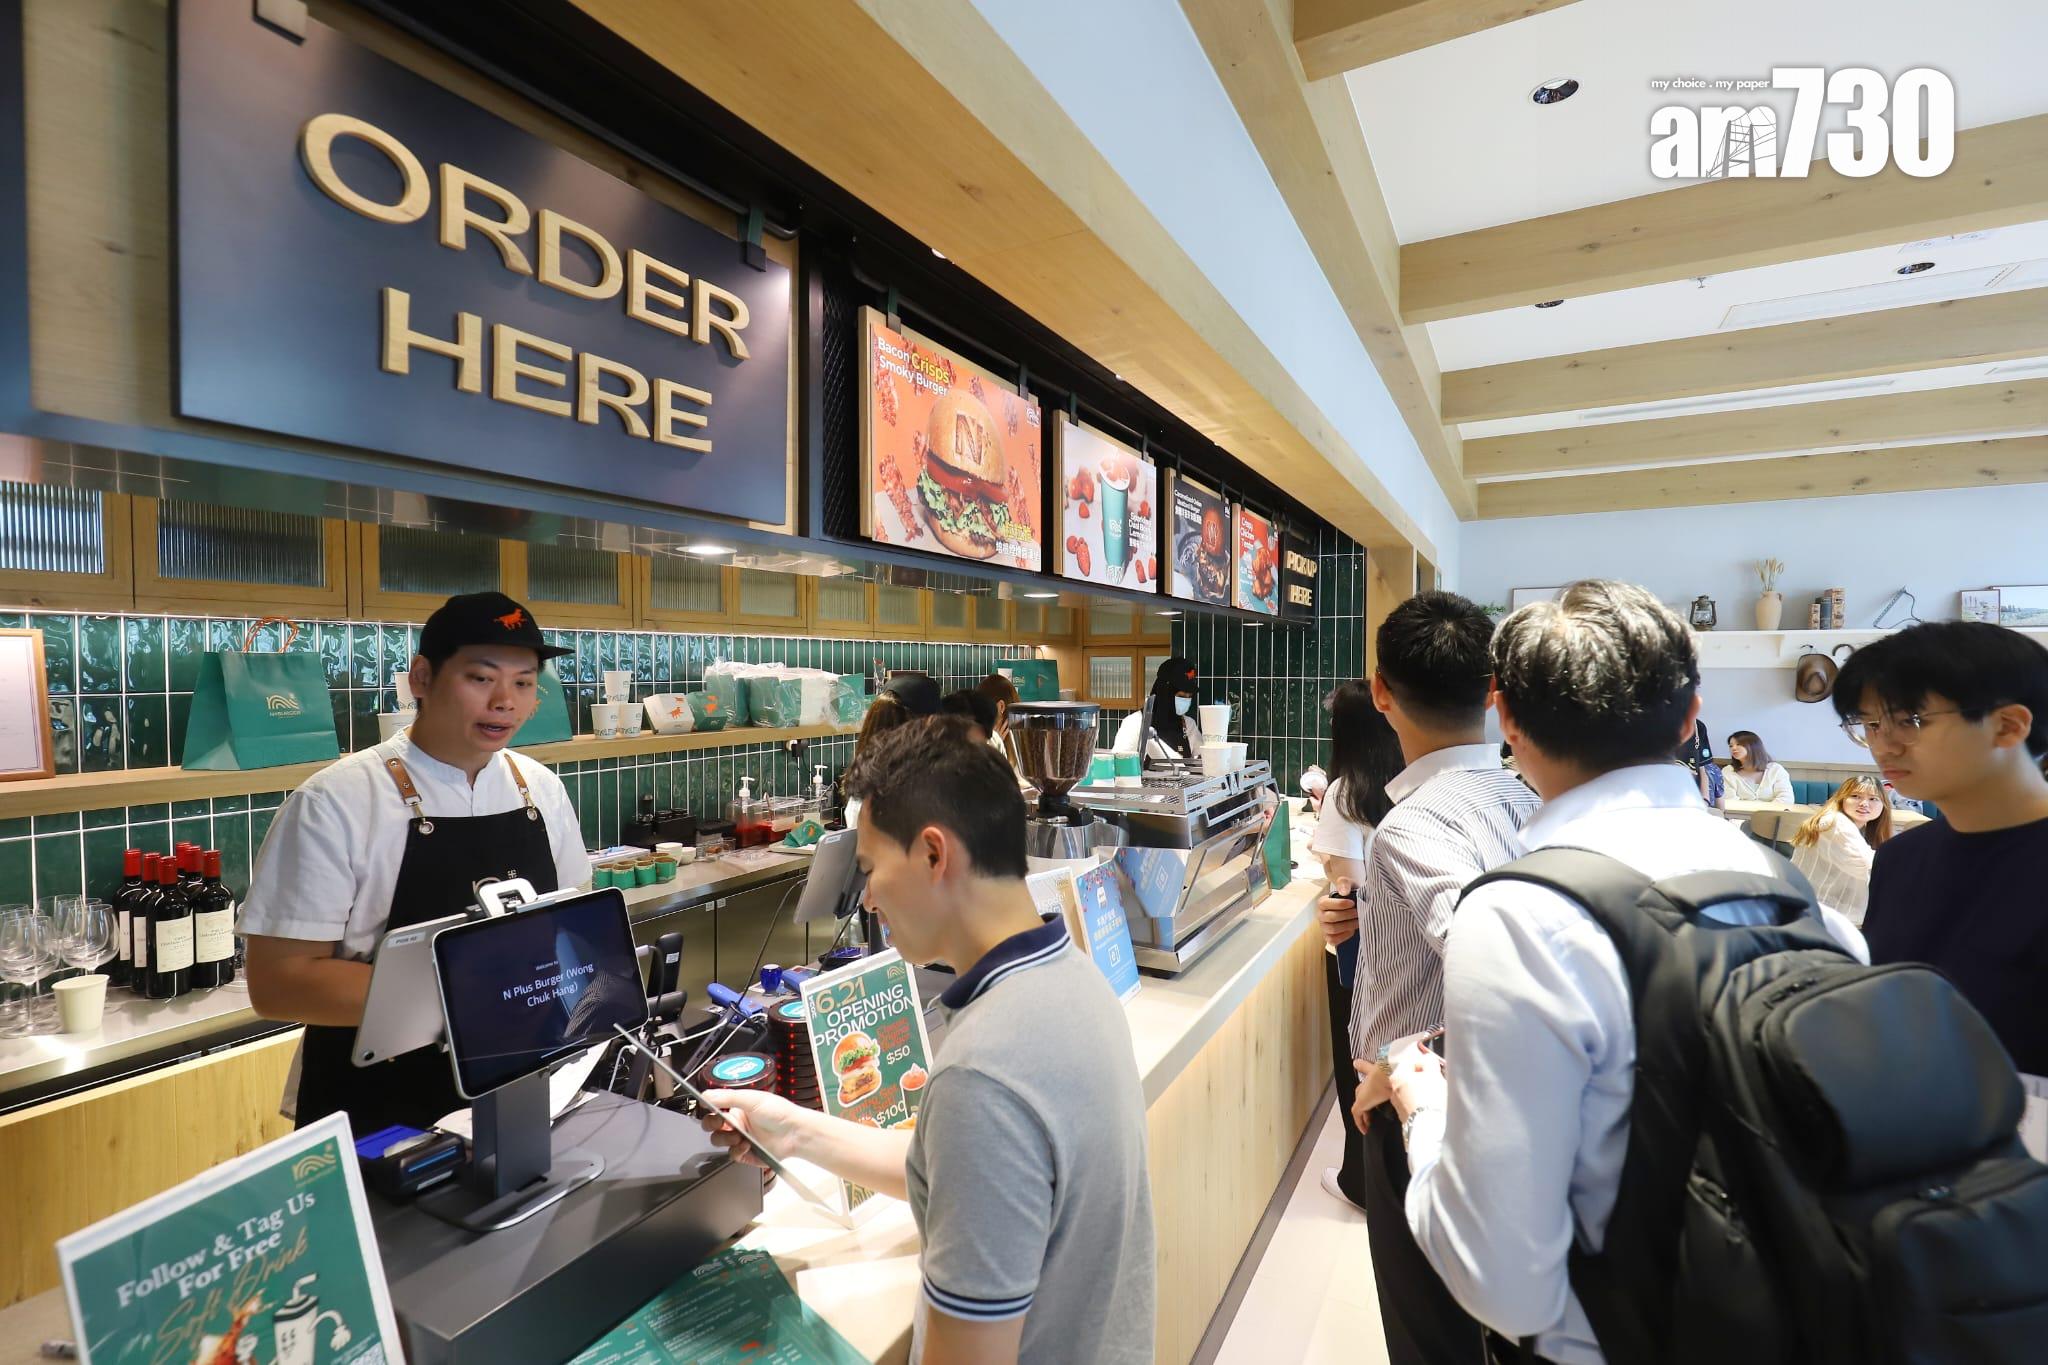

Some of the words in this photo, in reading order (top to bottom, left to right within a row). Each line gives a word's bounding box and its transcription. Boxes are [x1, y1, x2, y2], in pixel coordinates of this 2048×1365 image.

[304, 113, 751, 360] ORDER
[381, 287, 713, 453] HERE
[878, 336, 910, 362] Bacon
[911, 352, 950, 384] Crisps
[879, 355, 914, 383] Smoky
[916, 372, 949, 397] Burger
[1289, 584, 1313, 607] HERE
[502, 989, 512, 1001] N
[513, 984, 533, 997] Plus
[534, 973, 564, 991] Burger
[566, 963, 594, 980] (Wong
[527, 991, 550, 1008] Chuk
[552, 981, 578, 999] Hang)
[815, 977, 866, 1014] 6.21
[814, 995, 915, 1047] PROMOTION
[826, 983, 904, 1028] OPENING
[886, 1044, 910, 1065] $50
[876, 1099, 907, 1125] $100
[115, 1248, 208, 1308] Follow
[212, 1233, 235, 1257] &
[236, 1209, 285, 1242] Tag
[286, 1191, 316, 1216] Us
[176, 1262, 225, 1300] For
[228, 1231, 283, 1270] Free
[152, 1287, 223, 1365] Soft
[226, 1225, 309, 1315] Drink
